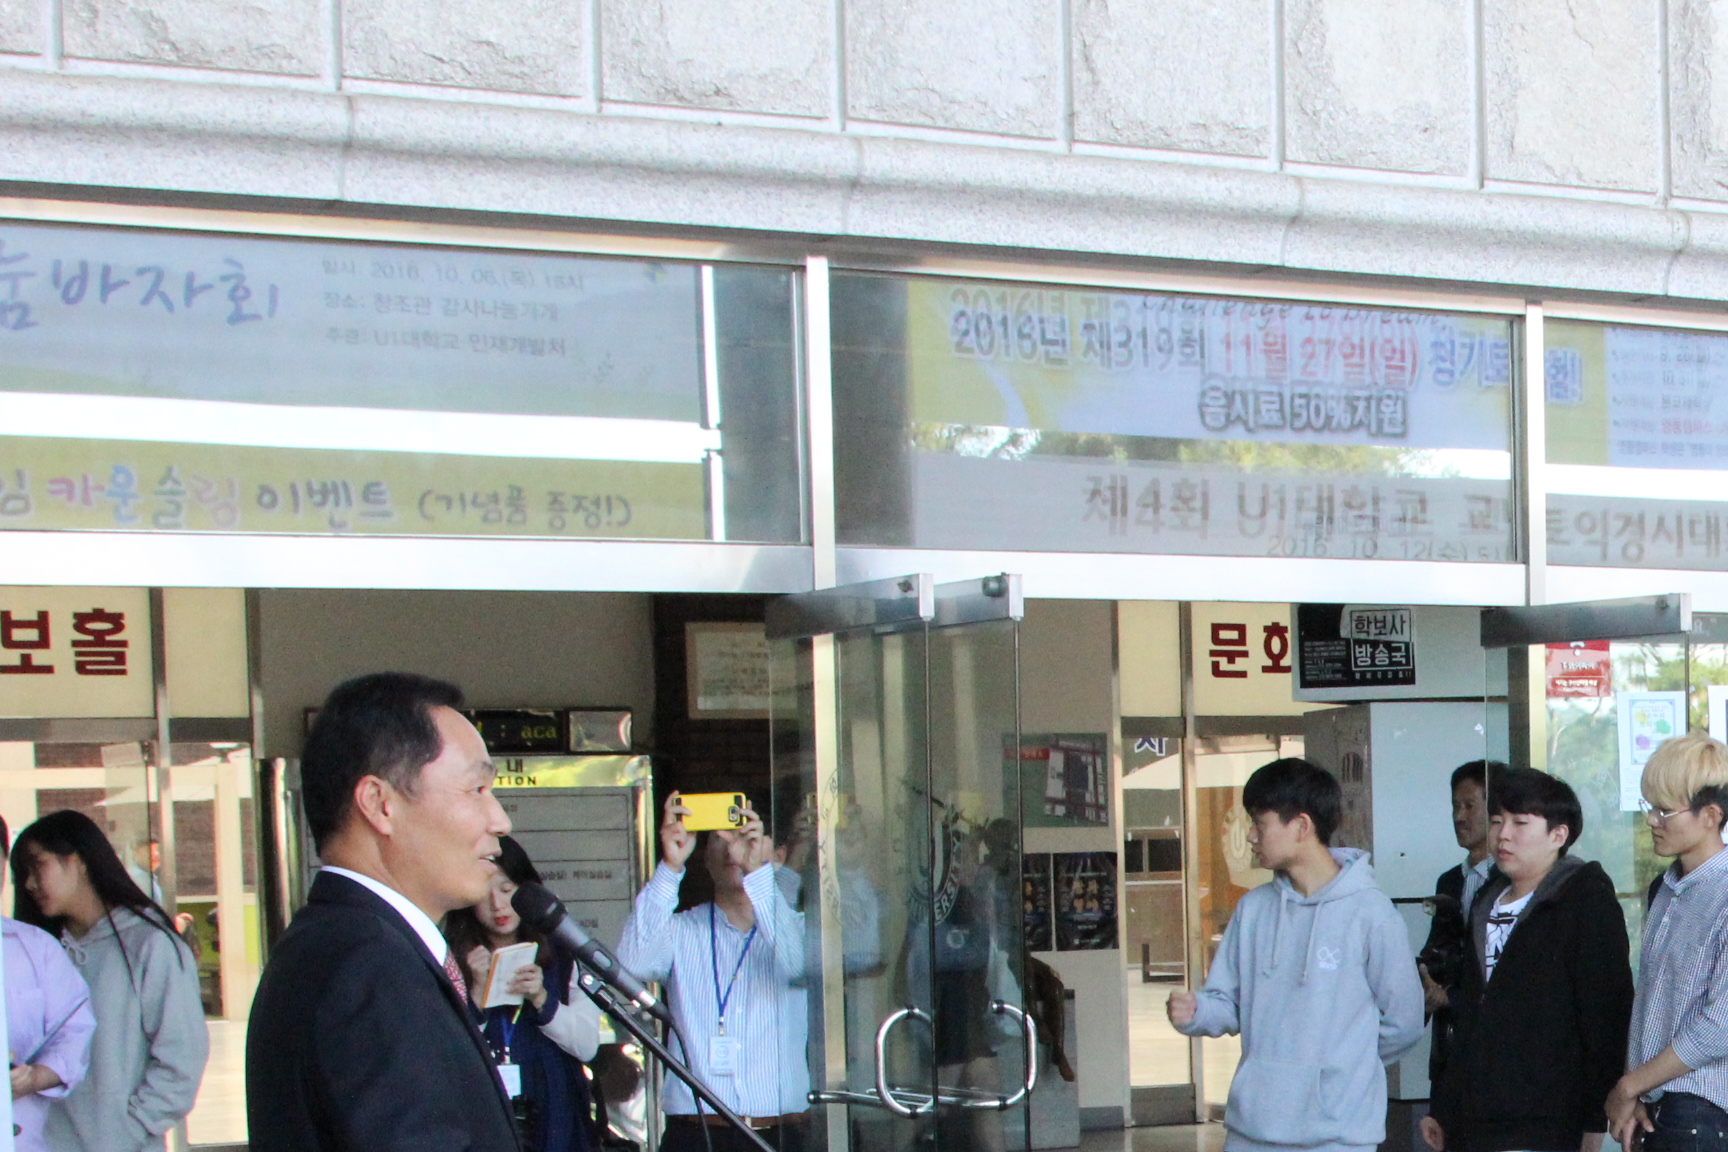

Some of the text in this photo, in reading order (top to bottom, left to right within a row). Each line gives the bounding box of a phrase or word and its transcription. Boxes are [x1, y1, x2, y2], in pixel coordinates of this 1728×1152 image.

[1291, 386, 1409, 438] 50%지원
[255, 478, 394, 529] 이벤트
[1082, 475, 1210, 540] 제4회
[1354, 613, 1407, 637] 학보사
[1354, 642, 1407, 667] 방송국
[496, 776, 537, 786] TION
